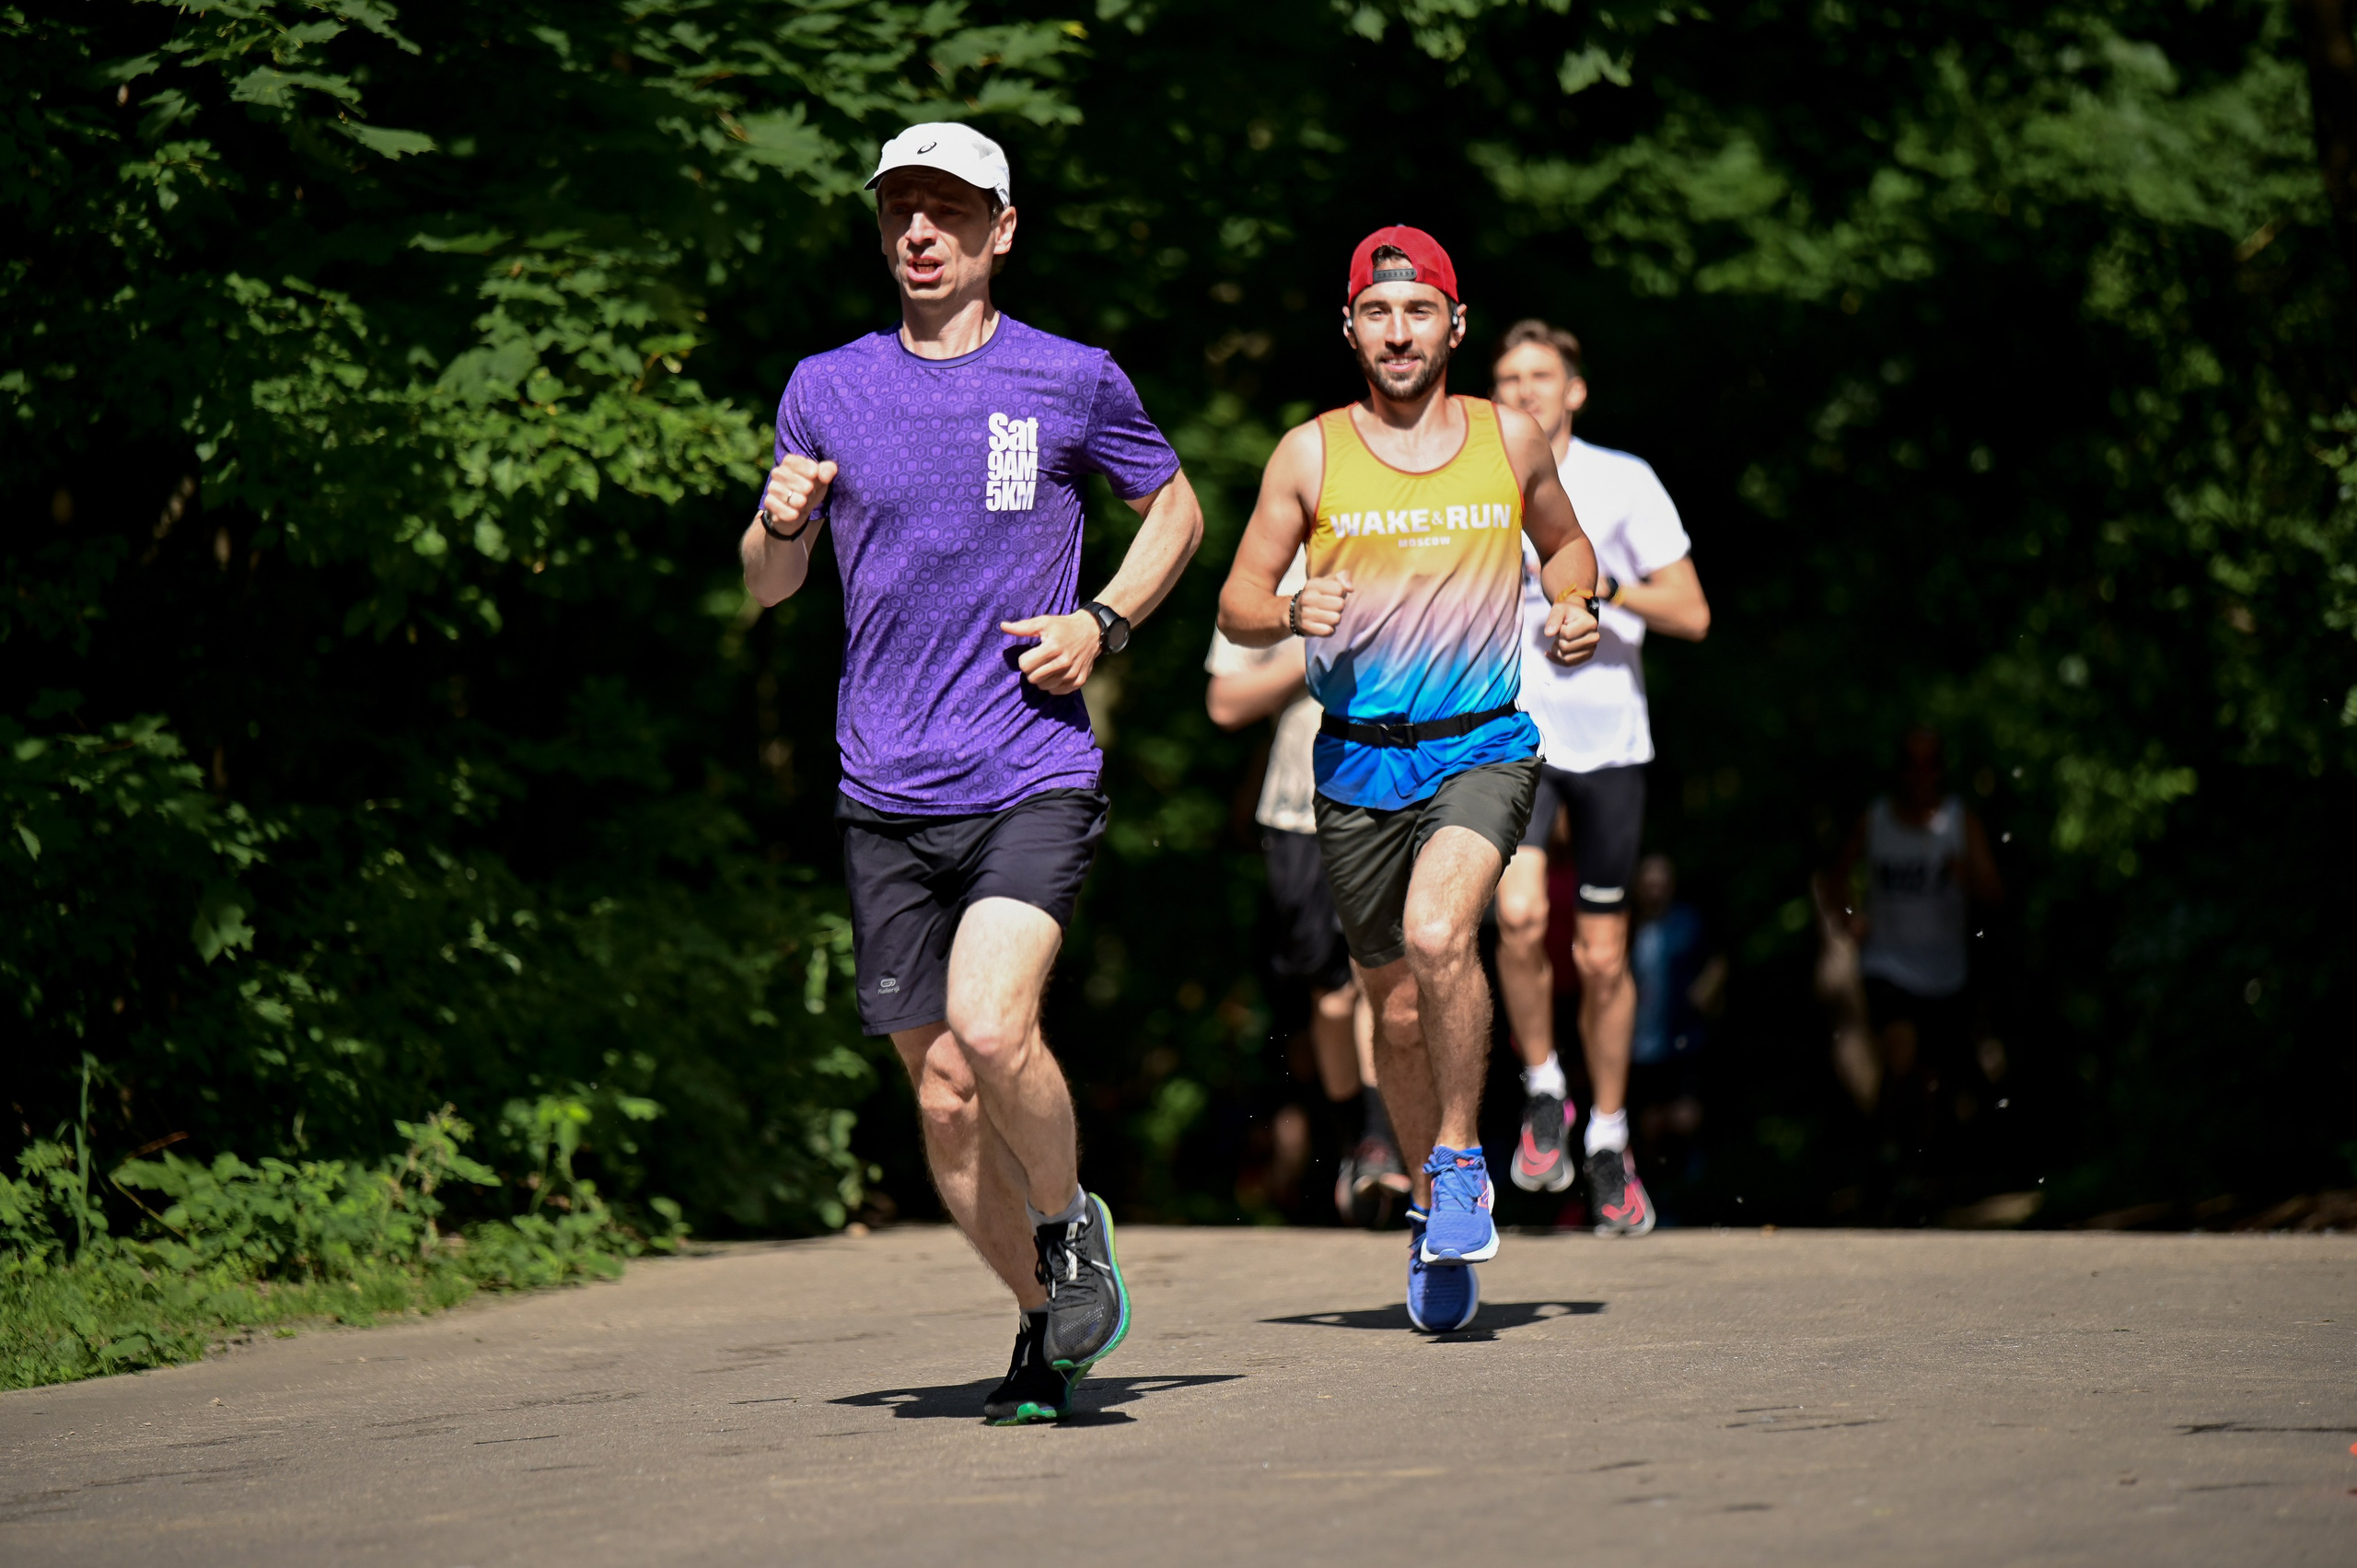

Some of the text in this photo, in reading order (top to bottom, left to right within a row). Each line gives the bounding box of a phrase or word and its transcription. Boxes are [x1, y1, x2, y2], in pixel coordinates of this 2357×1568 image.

[988, 412, 1039, 452] Sat
[987, 450, 1039, 481] 9AM
[985, 481, 1037, 512] 5KM
[1398, 536, 1451, 548] MOSCOW
